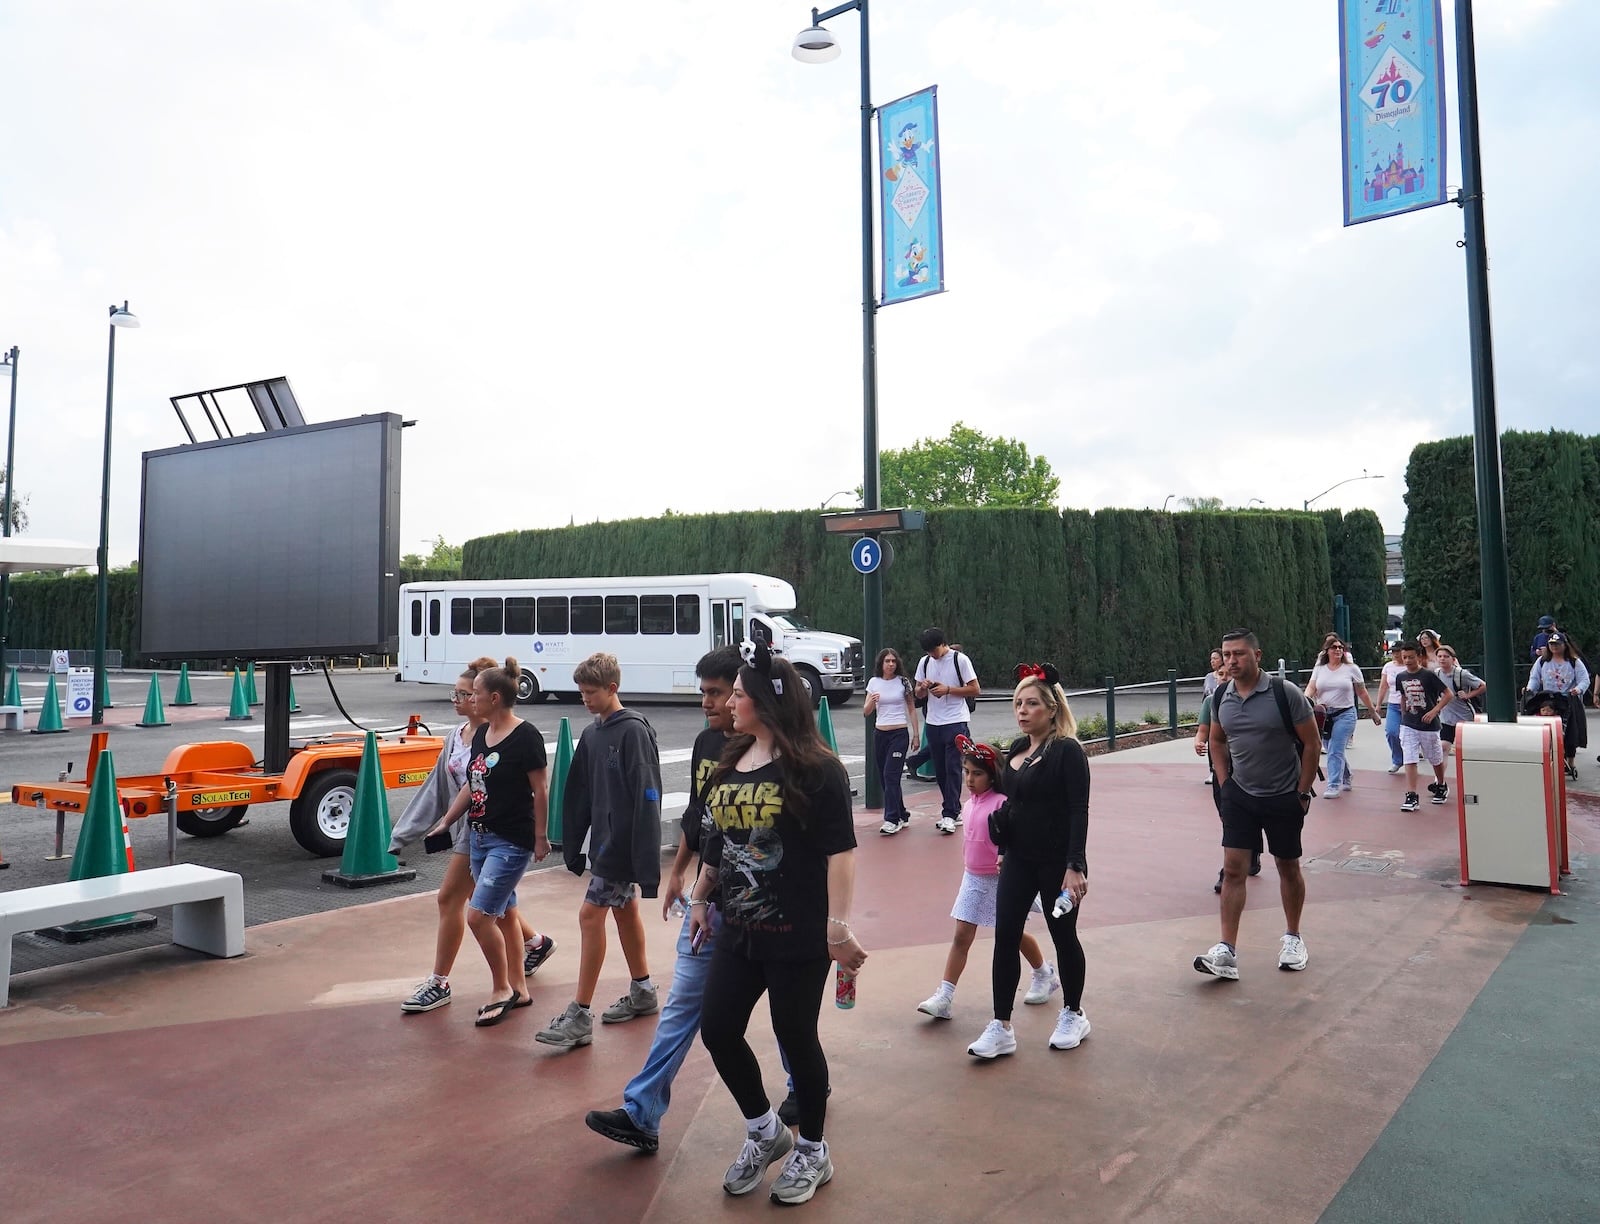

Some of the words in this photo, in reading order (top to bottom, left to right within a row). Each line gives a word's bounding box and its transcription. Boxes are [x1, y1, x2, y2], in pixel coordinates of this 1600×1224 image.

[1370, 79, 1412, 109] 70
[1375, 105, 1411, 121] Disneyland
[860, 544, 872, 567] 6
